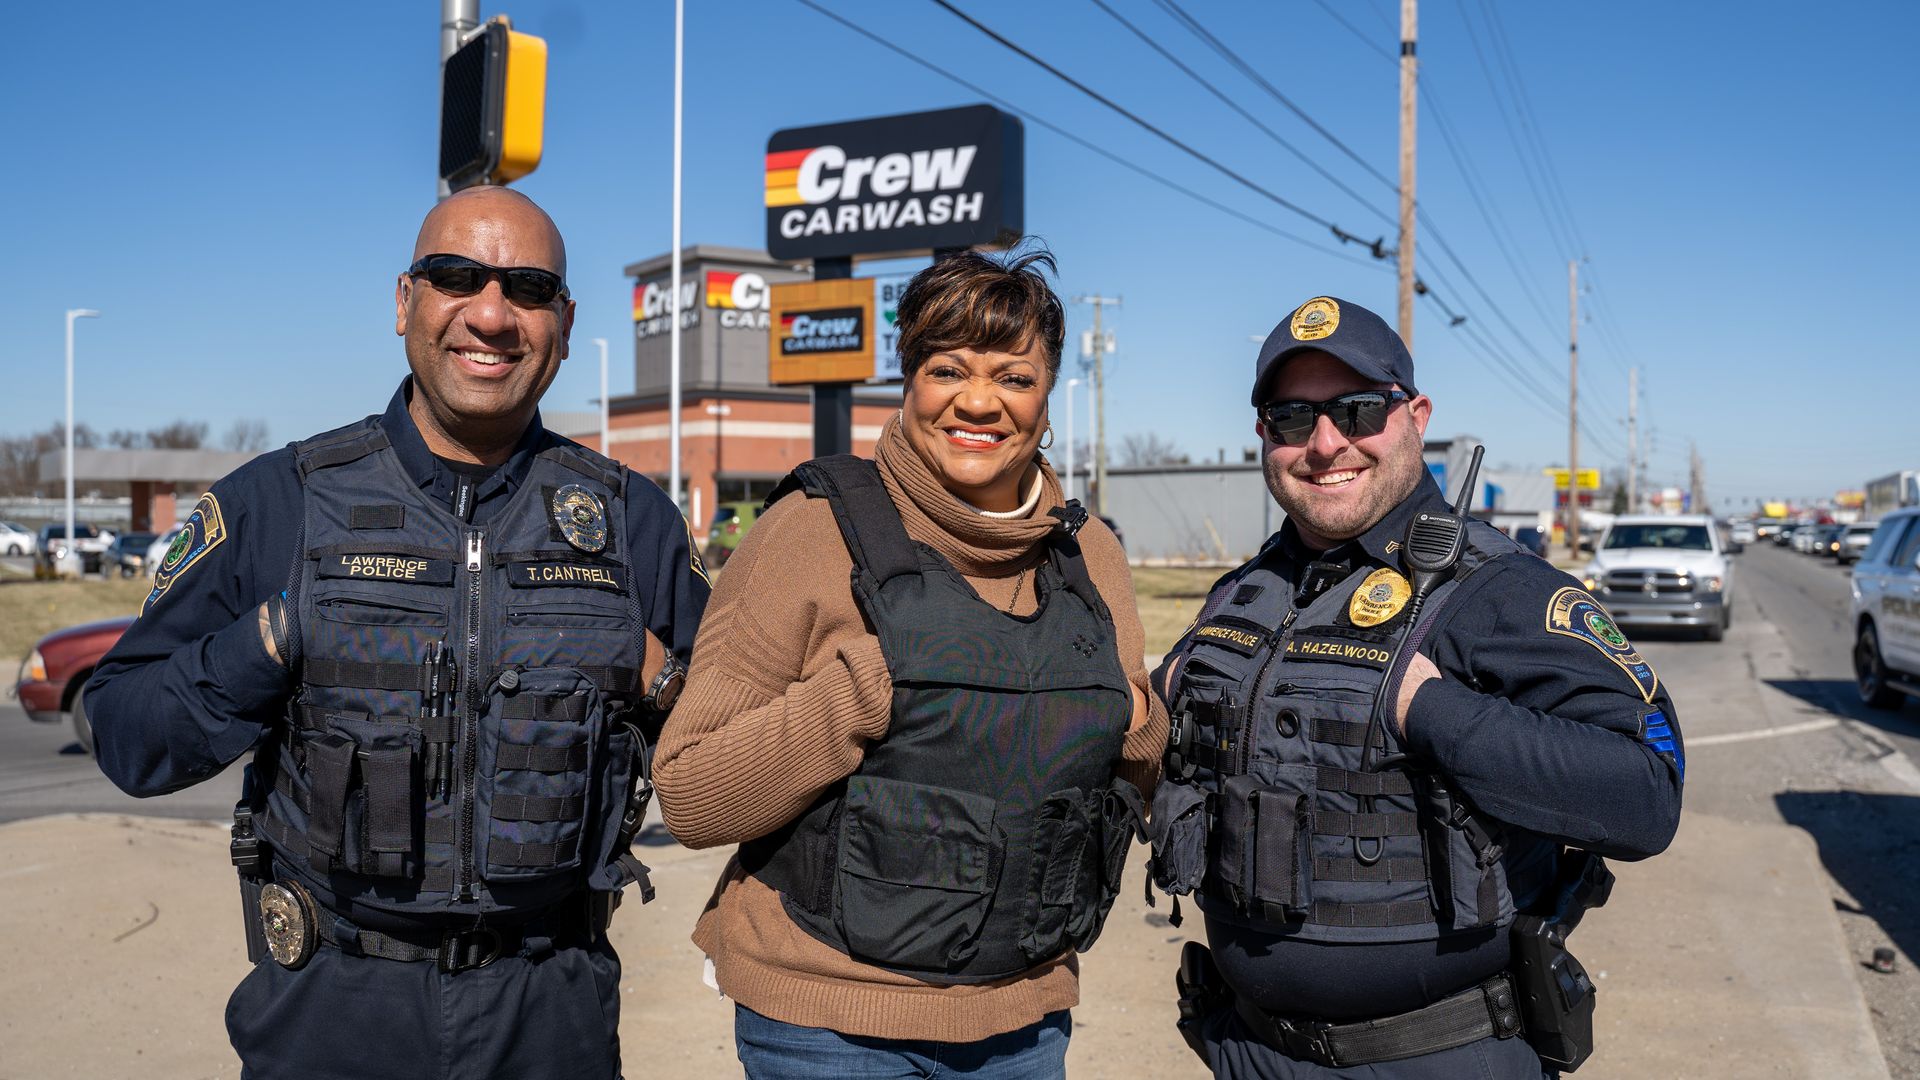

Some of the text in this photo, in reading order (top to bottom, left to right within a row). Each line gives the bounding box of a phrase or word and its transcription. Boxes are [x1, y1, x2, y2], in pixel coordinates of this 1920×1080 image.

[797, 145, 977, 204] Crew
[780, 192, 984, 239] CARWASH
[791, 315, 858, 338] Crew
[783, 335, 860, 352] CARWASH
[341, 555, 428, 571] LAWRENCE
[350, 565, 416, 579] POLICE
[543, 566, 617, 587] CANTRELL
[1227, 630, 1259, 647] POLICE
[1285, 640, 1390, 663] A. HAZELWOOD
